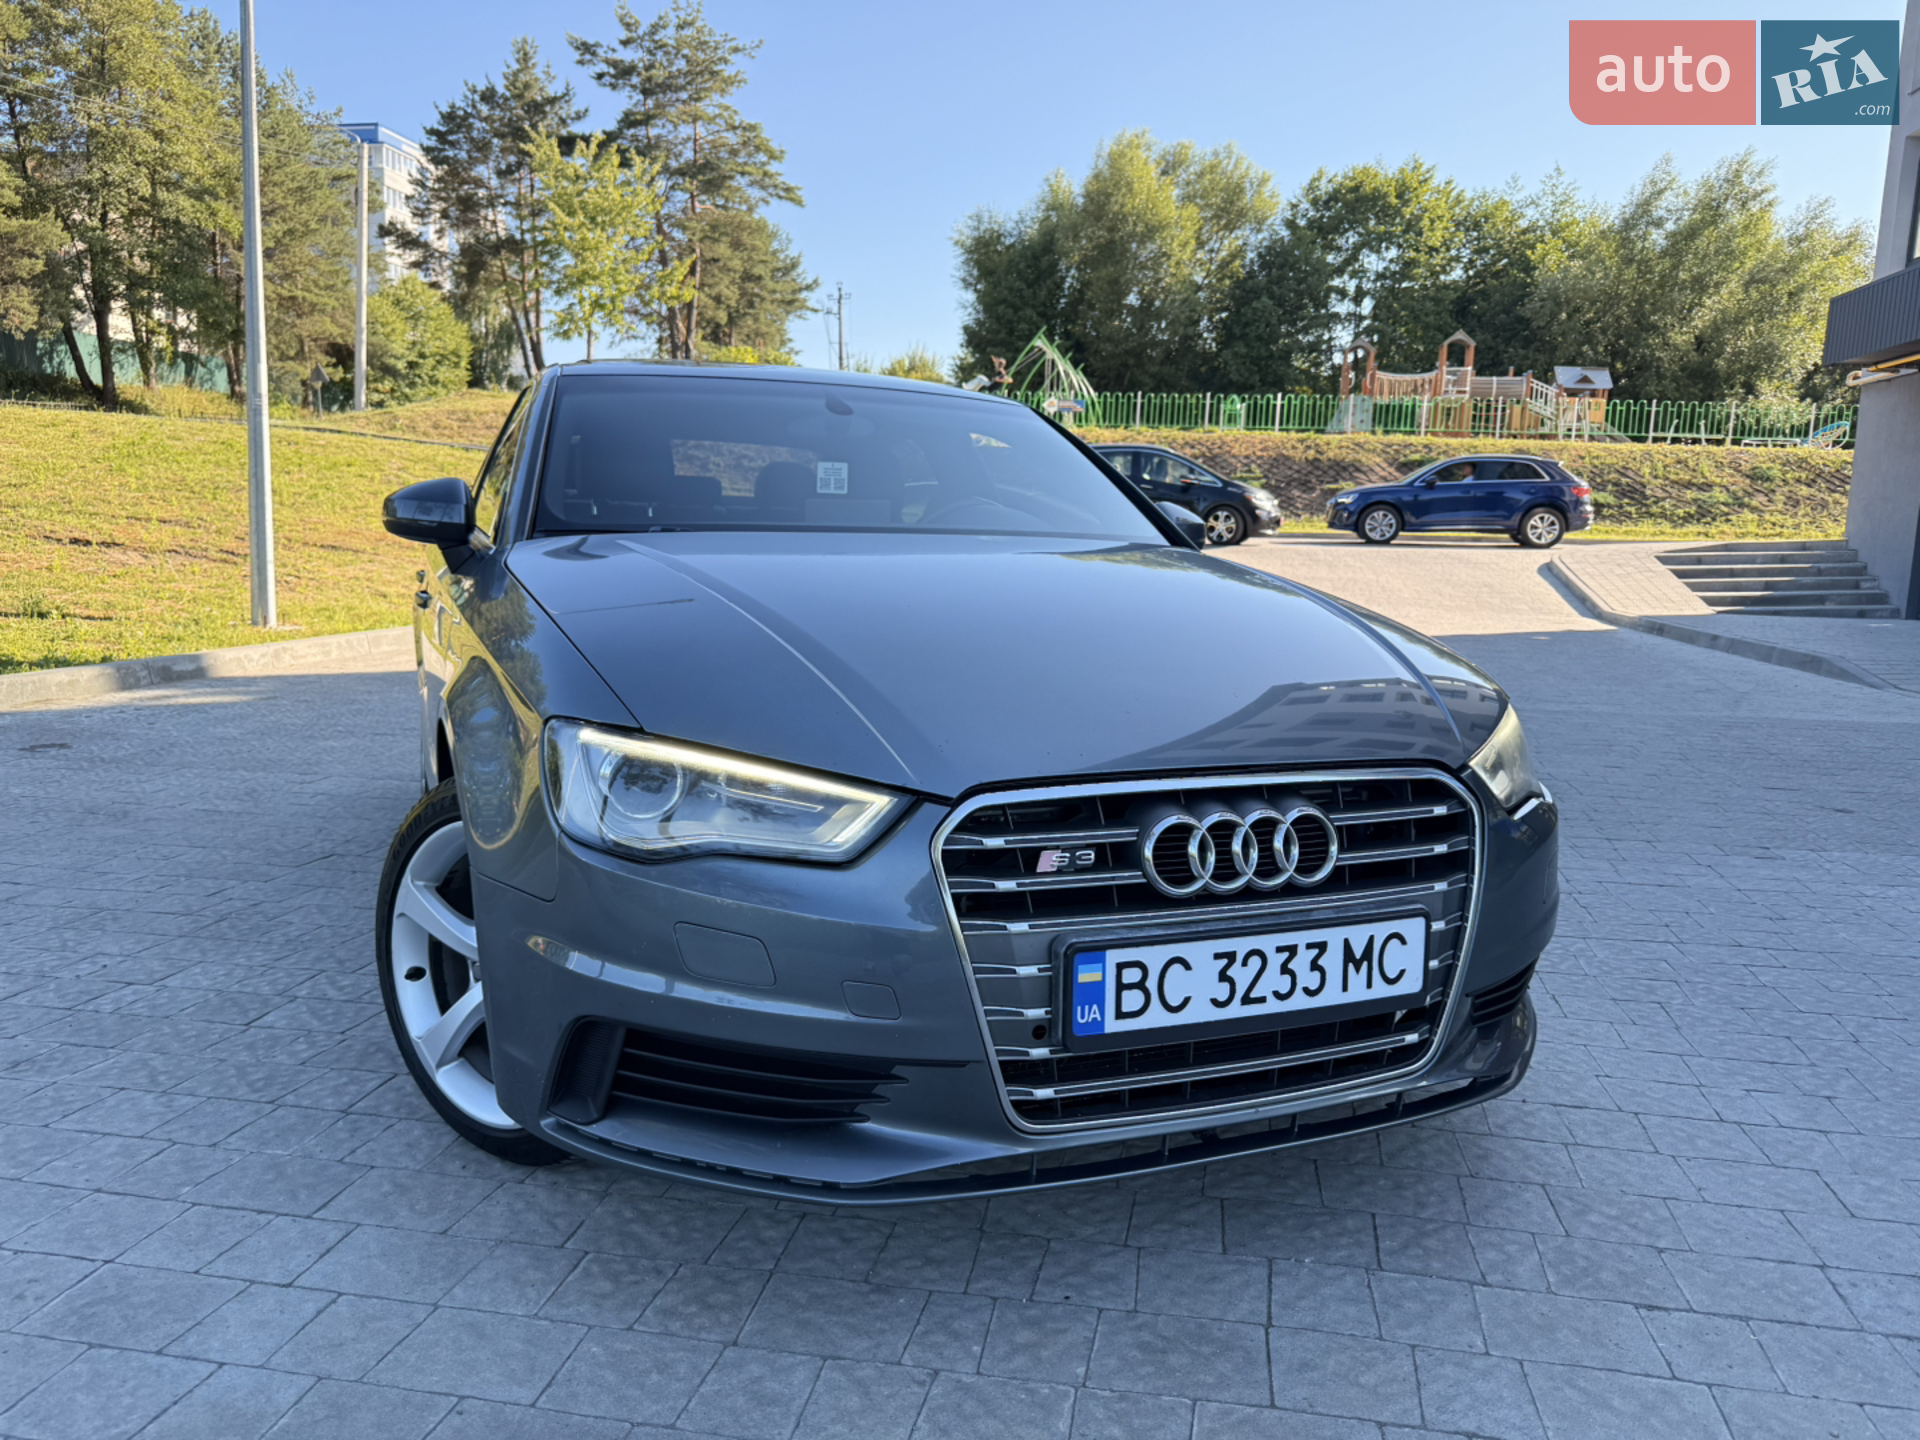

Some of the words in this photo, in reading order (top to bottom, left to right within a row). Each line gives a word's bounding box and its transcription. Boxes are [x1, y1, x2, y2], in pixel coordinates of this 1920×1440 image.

[392, 793, 457, 860] GOODYEA
[1049, 850, 1095, 867] S3
[1114, 956, 1193, 1020] BC
[1209, 941, 1329, 1009] 3233
[1342, 931, 1408, 993] MC
[1077, 1004, 1101, 1024] UA
